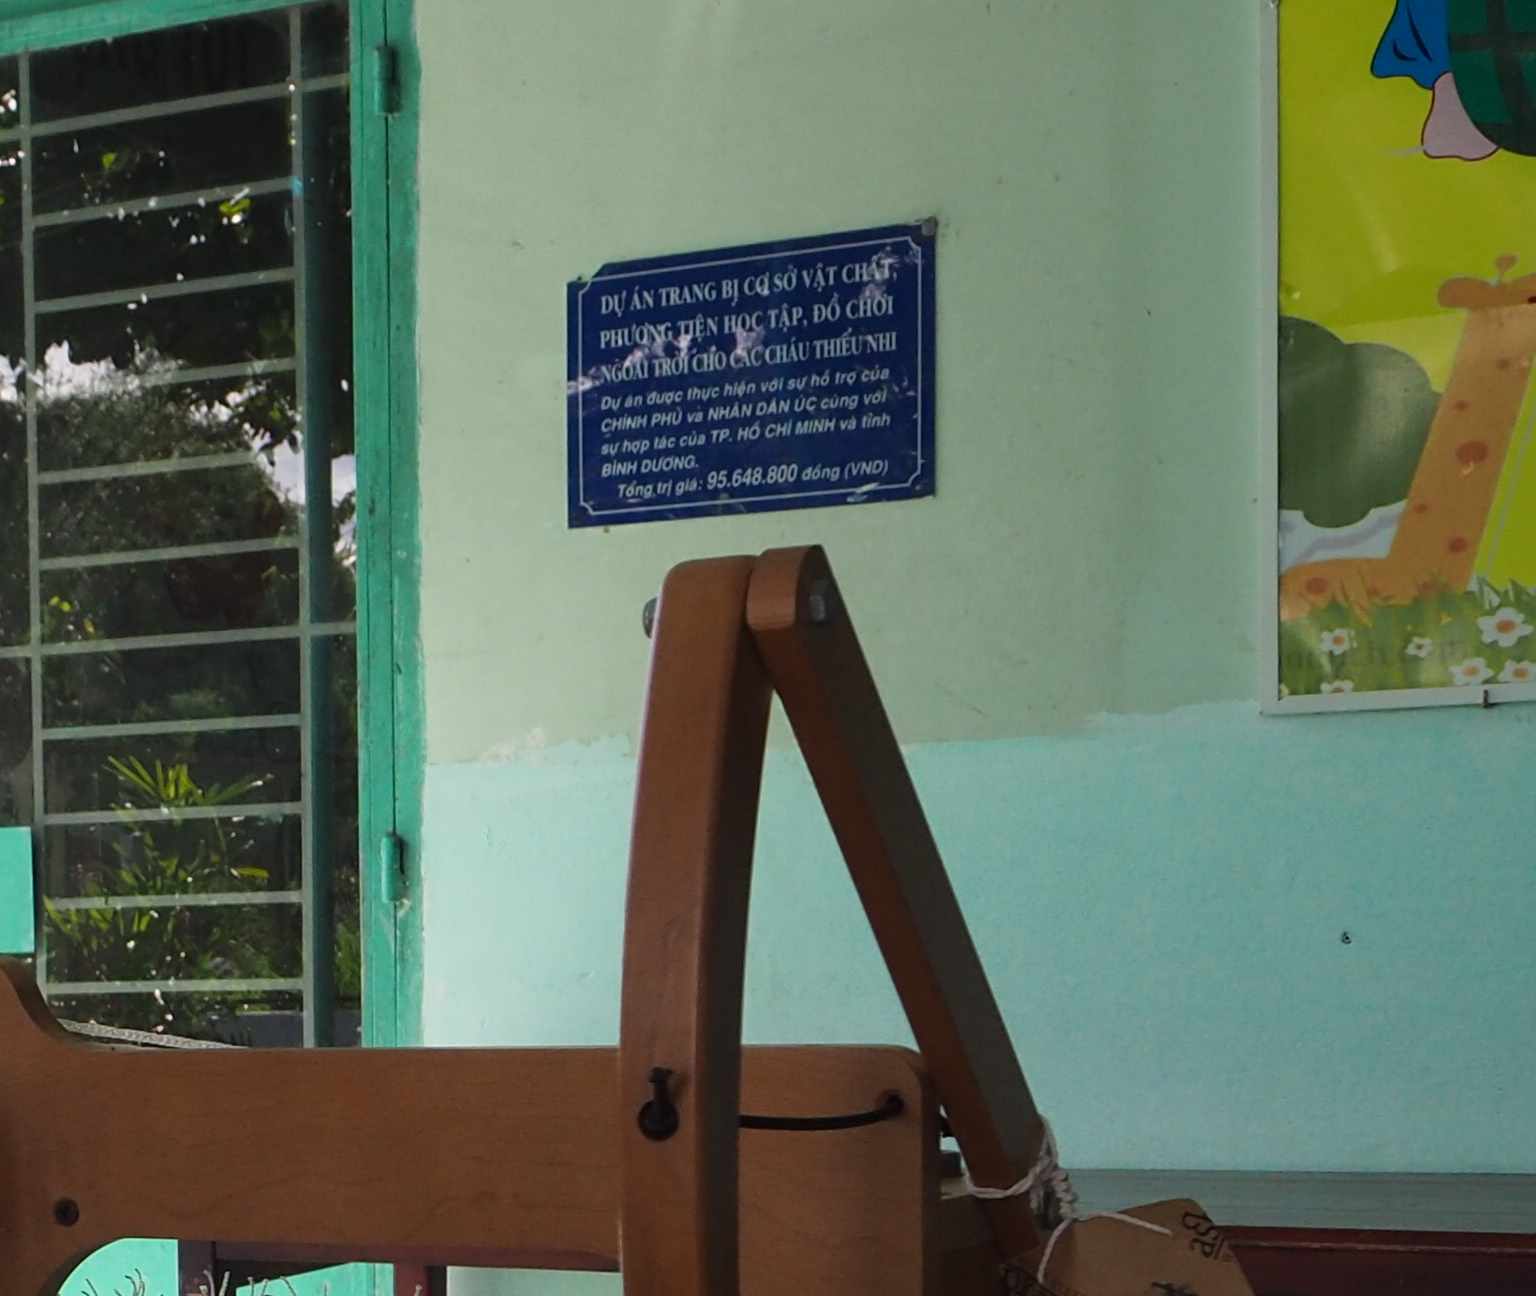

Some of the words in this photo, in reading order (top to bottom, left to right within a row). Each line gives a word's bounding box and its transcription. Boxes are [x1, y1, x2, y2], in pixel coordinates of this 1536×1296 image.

[600, 289, 627, 317] DỰ
[630, 285, 654, 310] ÁN
[658, 281, 717, 307] TRANG
[802, 262, 838, 292] VẬT
[692, 351, 727, 373] CHO
[764, 337, 810, 365] CHÁU
[866, 331, 897, 353] NHI
[600, 413, 647, 433] CHÍNH
[794, 395, 818, 413] ÚC
[710, 428, 733, 444] TP.
[795, 417, 835, 435] MINH
[706, 463, 799, 490] 95.648.800
